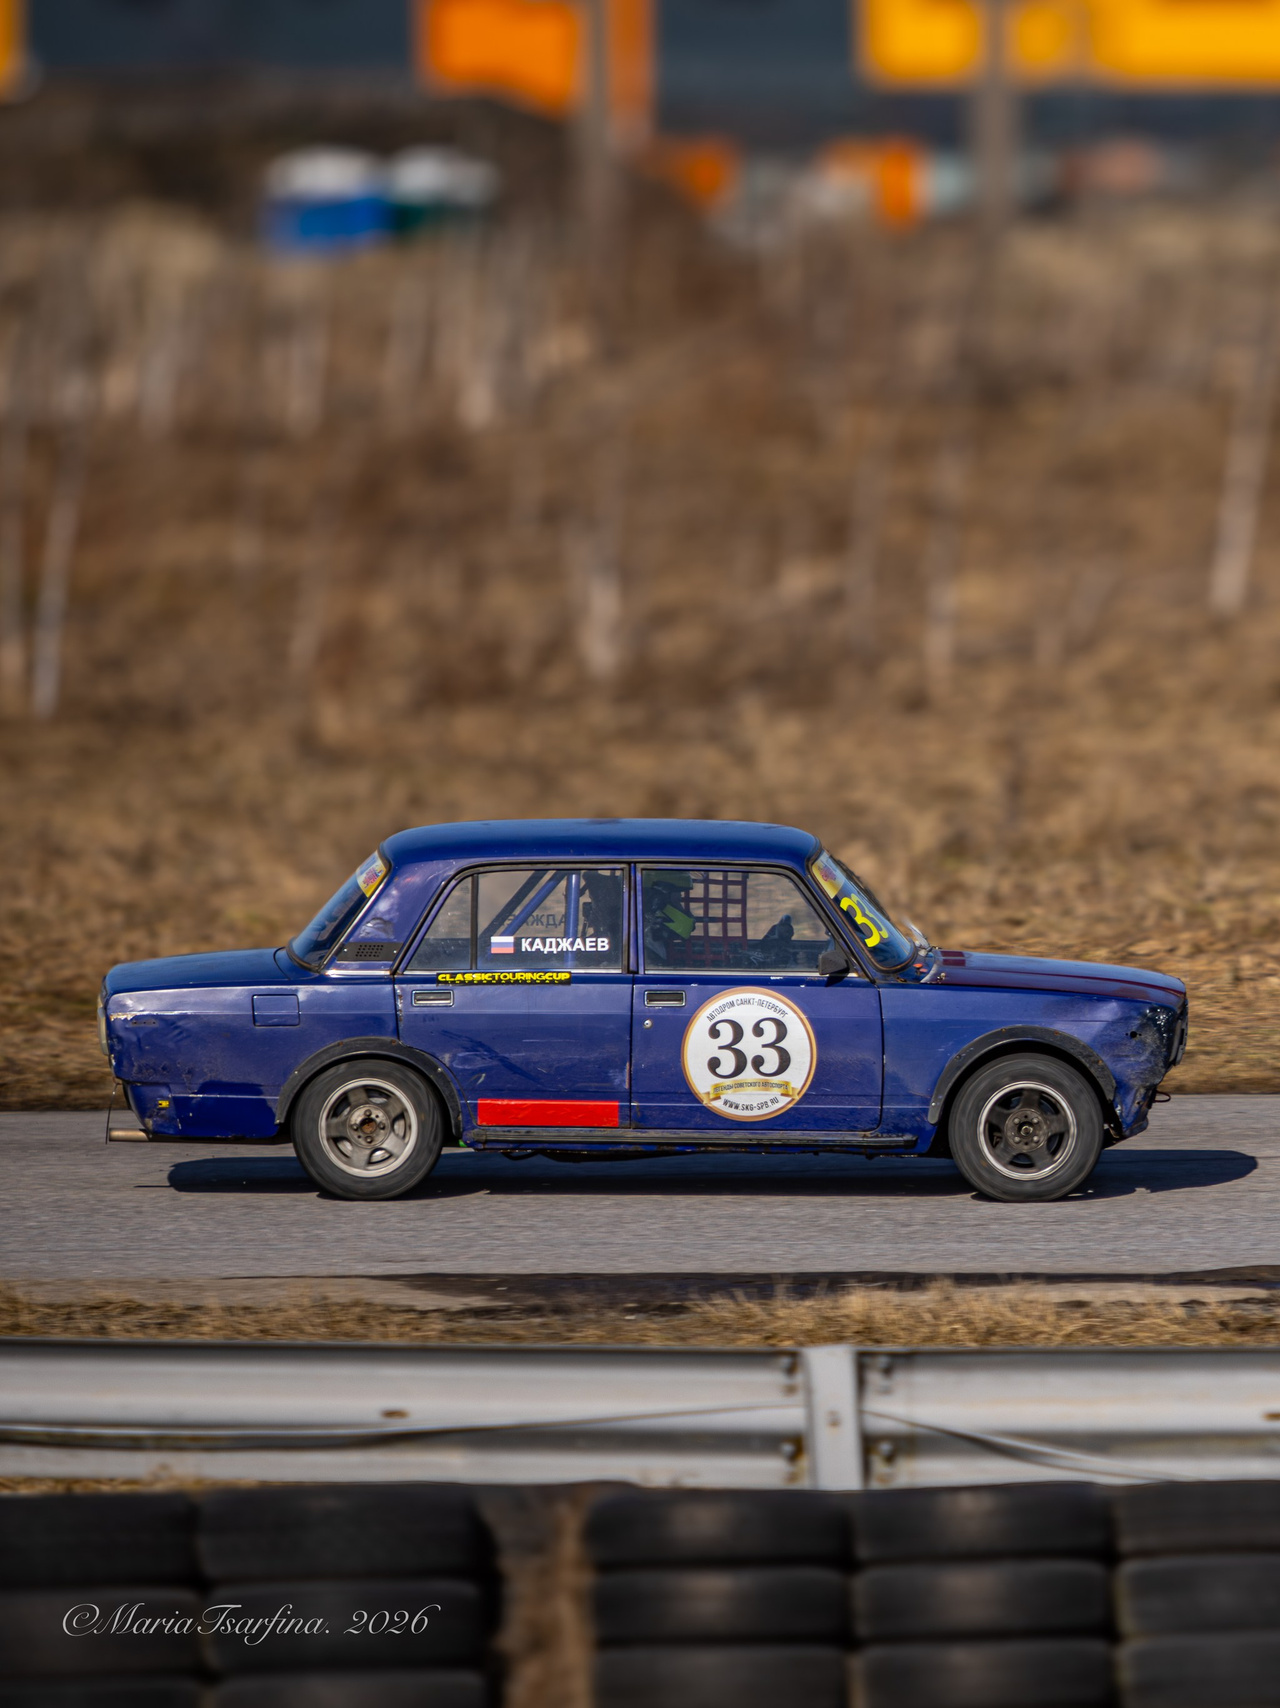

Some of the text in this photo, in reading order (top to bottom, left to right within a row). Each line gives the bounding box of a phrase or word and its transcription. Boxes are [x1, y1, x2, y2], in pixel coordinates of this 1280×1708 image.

[521, 937, 610, 954] КАДЖАЕВ
[706, 997, 789, 1022] АВТОДРОМ САНКТ-ПЕТЕРБУРГ
[707, 1017, 791, 1079] 33
[722, 1096, 779, 1111] WWW.SKG-SPB.RU
